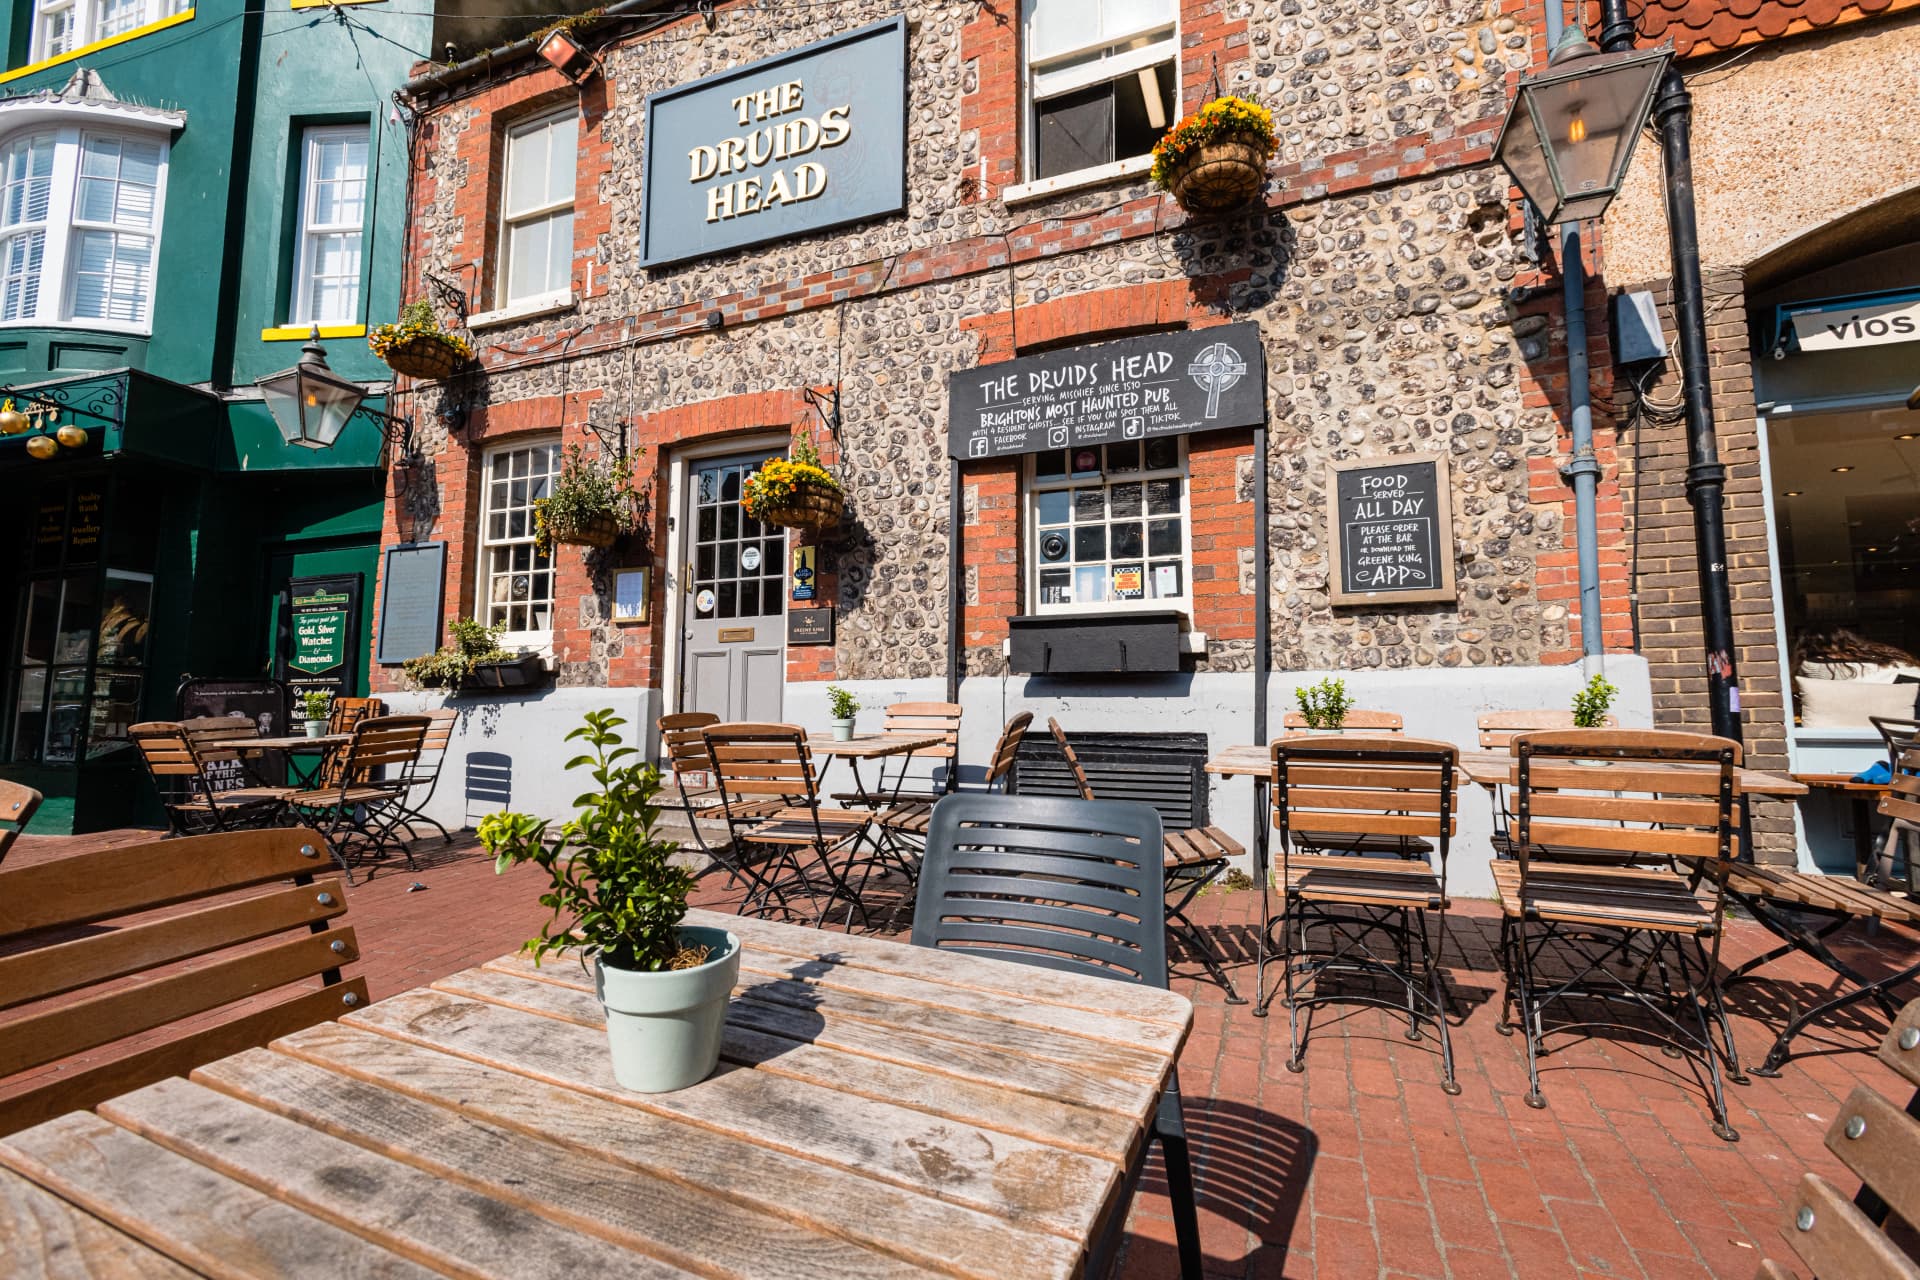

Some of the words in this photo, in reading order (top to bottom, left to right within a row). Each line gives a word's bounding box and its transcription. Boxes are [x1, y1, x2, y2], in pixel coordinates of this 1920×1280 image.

[731, 79, 804, 126] THE
[688, 104, 851, 183] DRUIDS
[705, 162, 828, 224] HEAD
[979, 374, 1019, 404] THE
[1029, 363, 1098, 393] DRUIDS
[1112, 351, 1174, 382] HEAD
[1022, 394, 1055, 406] SERVING
[1059, 387, 1095, 400] MISCHIEF
[1099, 383, 1120, 395] SINCE
[1045, 401, 1077, 419] MOST
[1081, 392, 1139, 414] HAUNTED
[1144, 388, 1170, 405] PUB
[972, 428, 988, 437] WITH
[997, 424, 1026, 434] RESIDENT
[1062, 417, 1075, 426] SEE
[1077, 415, 1086, 423] IF
[1087, 412, 1102, 422] YOU
[1104, 410, 1118, 420] CAN
[1120, 407, 1138, 417] SPOT
[1140, 404, 1160, 415] THEM
[1164, 402, 1178, 411] ALL
[1150, 412, 1181, 425] TIKTOK
[1075, 420, 1116, 434] INSTAGRAM
[994, 432, 1028, 445] FACEBOOK
[1360, 474, 1408, 495] FOOD
[1372, 489, 1405, 500] SERVED
[1355, 501, 1385, 520] ALL
[1392, 498, 1424, 516] DAY
[1361, 525, 1391, 536] PLEASE
[1392, 522, 1420, 532] ORDER
[1363, 535, 1374, 545] AT
[1376, 534, 1393, 544] THE
[1396, 533, 1413, 543] BAR
[1371, 545, 1402, 553] DOWNLOAD
[1403, 544, 1417, 552] THE
[1358, 554, 1394, 566] GREENE
[1398, 553, 1422, 564] KING
[1371, 565, 1411, 586] APP
[317, 625, 337, 634] Silver
[301, 636, 333, 646] Watches
[298, 654, 333, 664] Diamonds
